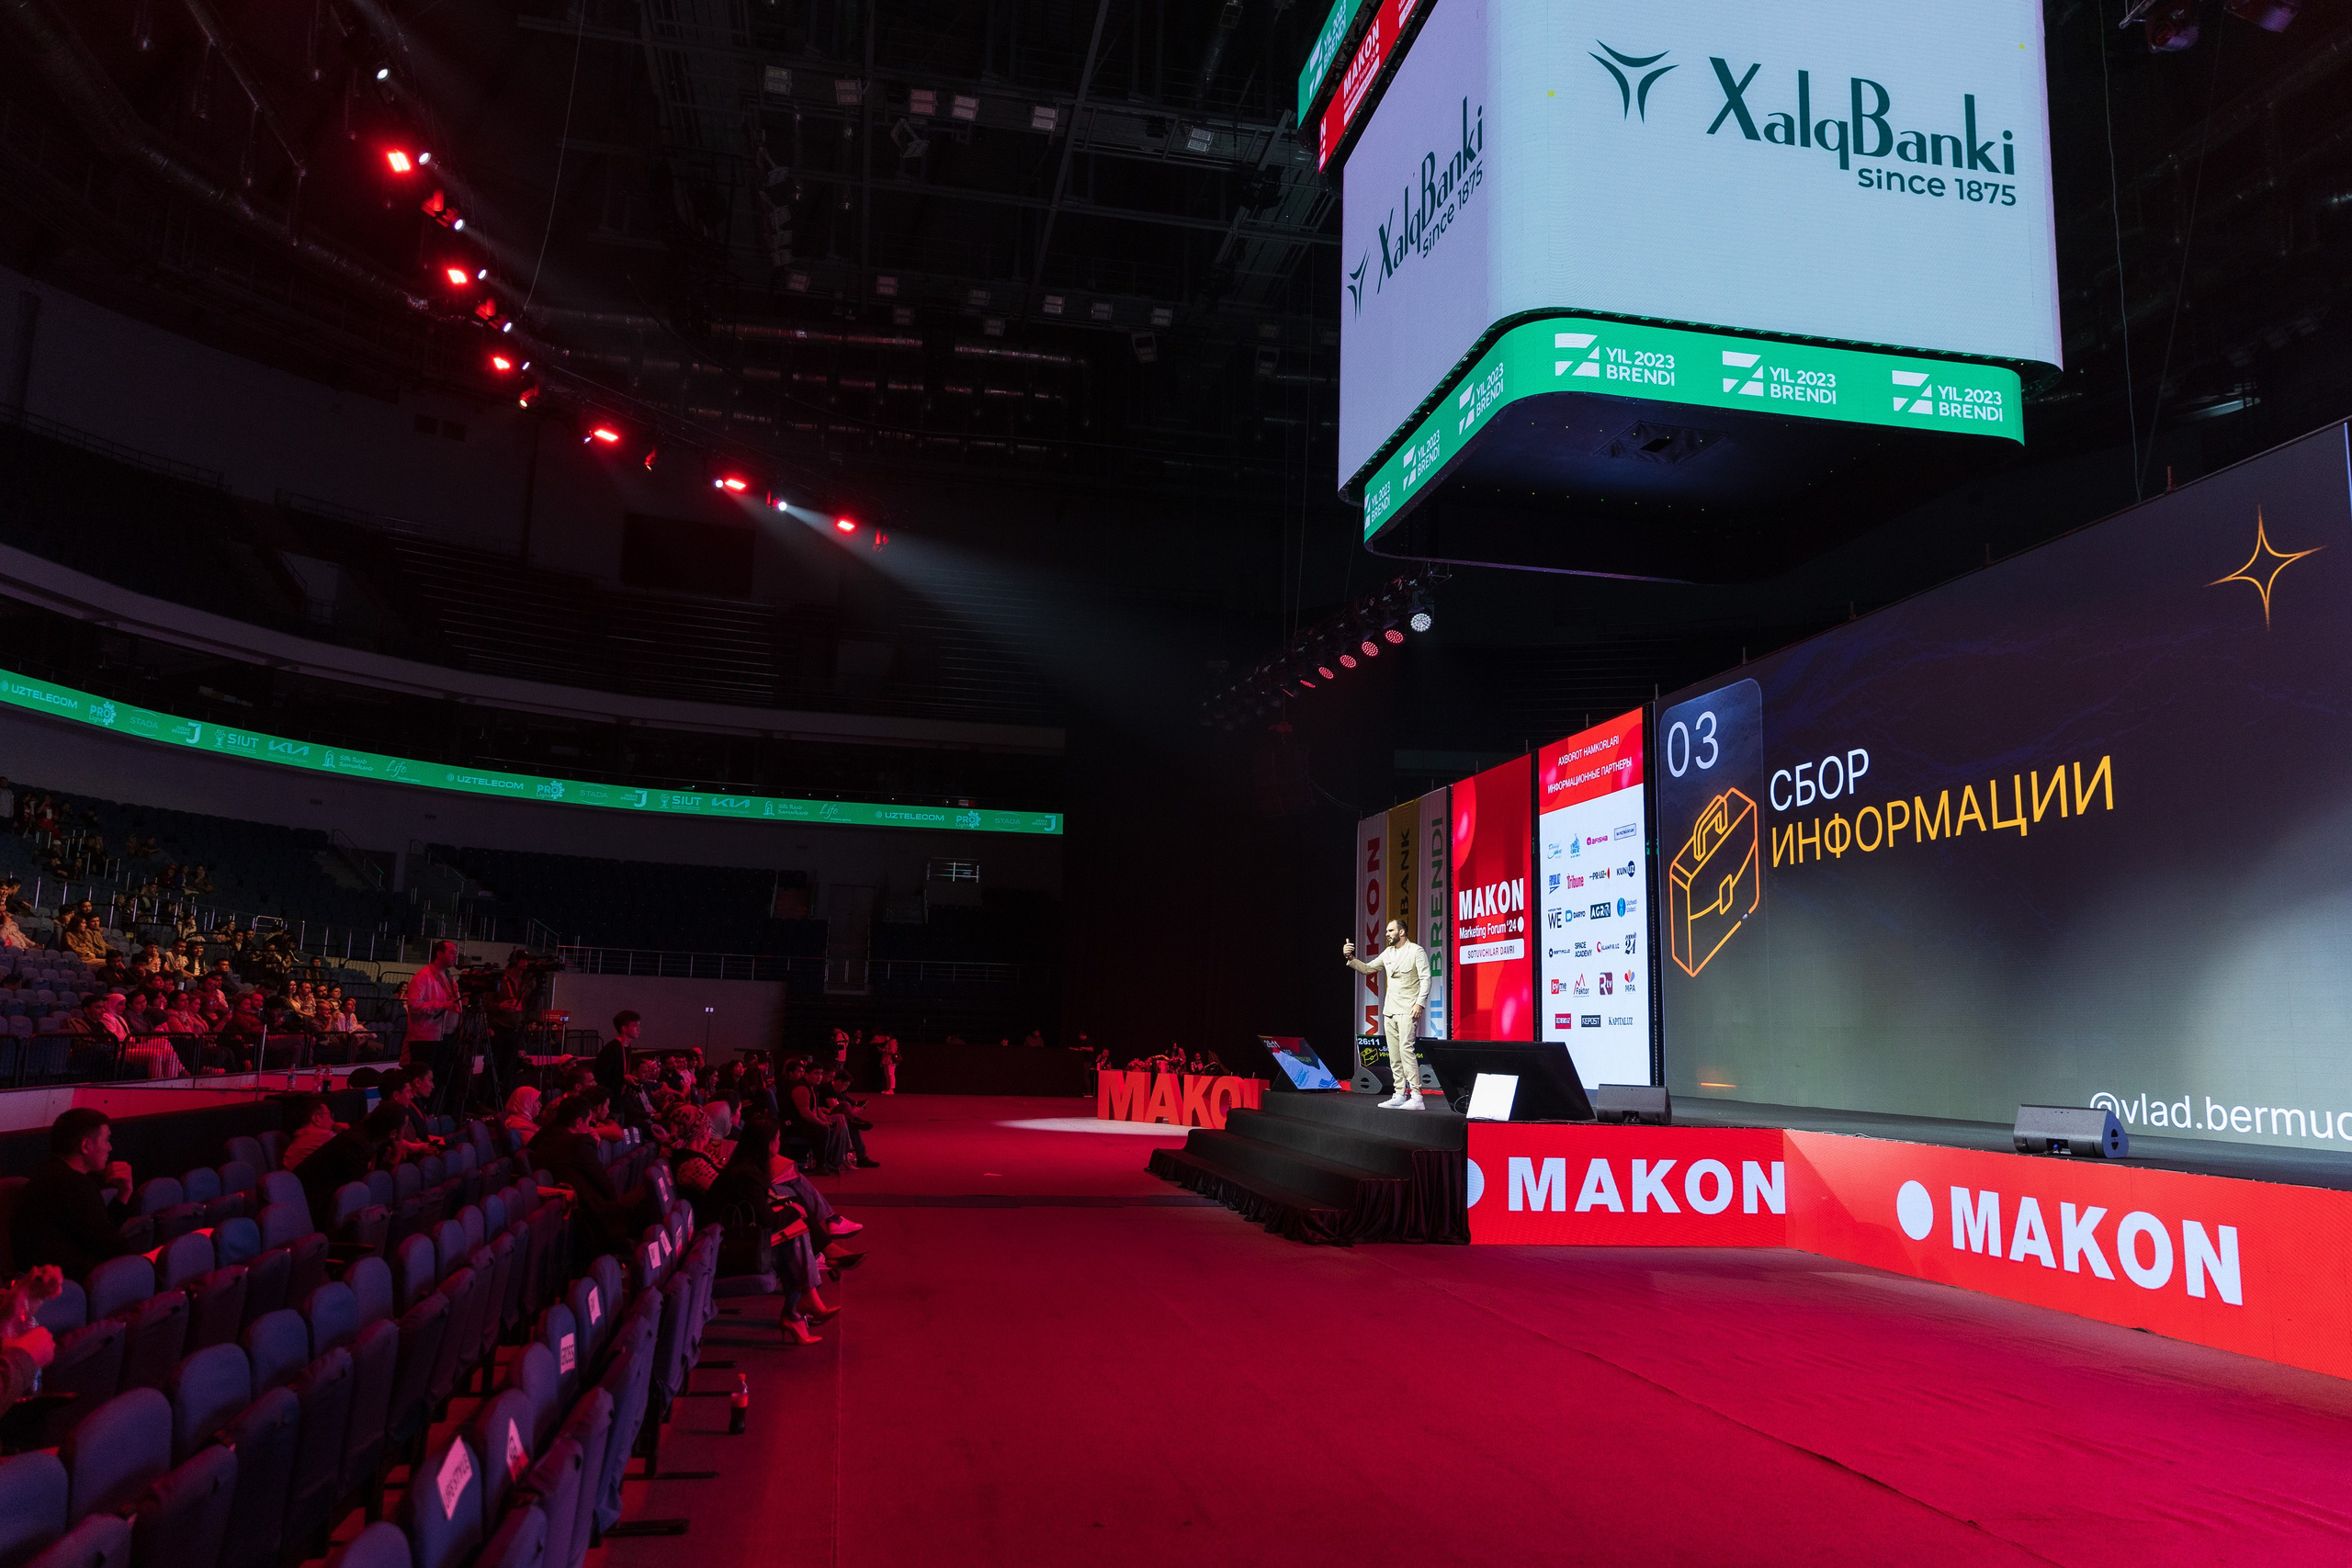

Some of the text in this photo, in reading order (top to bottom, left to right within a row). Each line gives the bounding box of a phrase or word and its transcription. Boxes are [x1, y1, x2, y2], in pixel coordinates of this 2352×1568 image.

[1324, 15, 1346, 70] BRENDI
[1343, 18, 1379, 100] MAKON
[1706, 56, 2016, 175] XalqBanki
[1377, 95, 1483, 296] XalqBanki
[1858, 167, 2017, 207] since 1875
[1422, 161, 1483, 259] since 1875
[1606, 346, 1675, 369] YIL 2023
[1476, 362, 1504, 398] YIL 2023
[1606, 365, 1675, 387] BRENDI
[1770, 367, 1837, 389] YIL 2023
[1476, 378, 1504, 418] BRENDI
[1770, 384, 1837, 405] BRENDI
[1938, 385, 2003, 406] YIL 2023
[1938, 402, 2004, 423] BRENDI
[1417, 429, 1440, 462] YIL 2023
[1417, 444, 1441, 477] BRENDI
[1379, 480, 1391, 502] 2023
[1371, 493, 1391, 523] BRENDI
[12, 683, 78, 709] UZTELECOM
[90, 705, 111, 719] PRO
[130, 716, 159, 729] STADA
[227, 733, 259, 749] SIUT
[1583, 735, 1620, 757] HAMKORLARI
[1667, 711, 1719, 778] 03
[458, 775, 524, 790] UZTELECOM
[537, 784, 559, 794] PRO
[1547, 757, 1632, 795] ИНФОРМАЦИОННЫЕ ПАРТНЕРЫ
[1770, 748, 1870, 811] СБОР
[580, 790, 608, 798] STADA
[672, 795, 702, 807] SIUT
[885, 812, 944, 821] UZTELECOM
[956, 816, 975, 824] PRO
[1772, 755, 2113, 868] ИНФОРМАЦИИ
[1400, 828, 1409, 920] BANK
[1430, 818, 1442, 976] BRENDI
[1459, 877, 1524, 920] MAKON
[1459, 924, 1486, 939] Marketing
[1487, 922, 1506, 935] Forum
[1548, 912, 1562, 929] WE
[1365, 837, 1380, 1035] MAKON
[1500, 945, 1515, 955] DAVRI
[1358, 1037, 1380, 1045] 26:11
[1508, 1156, 1786, 1214] MAKON
[1950, 1185, 2243, 1306] MAKON
